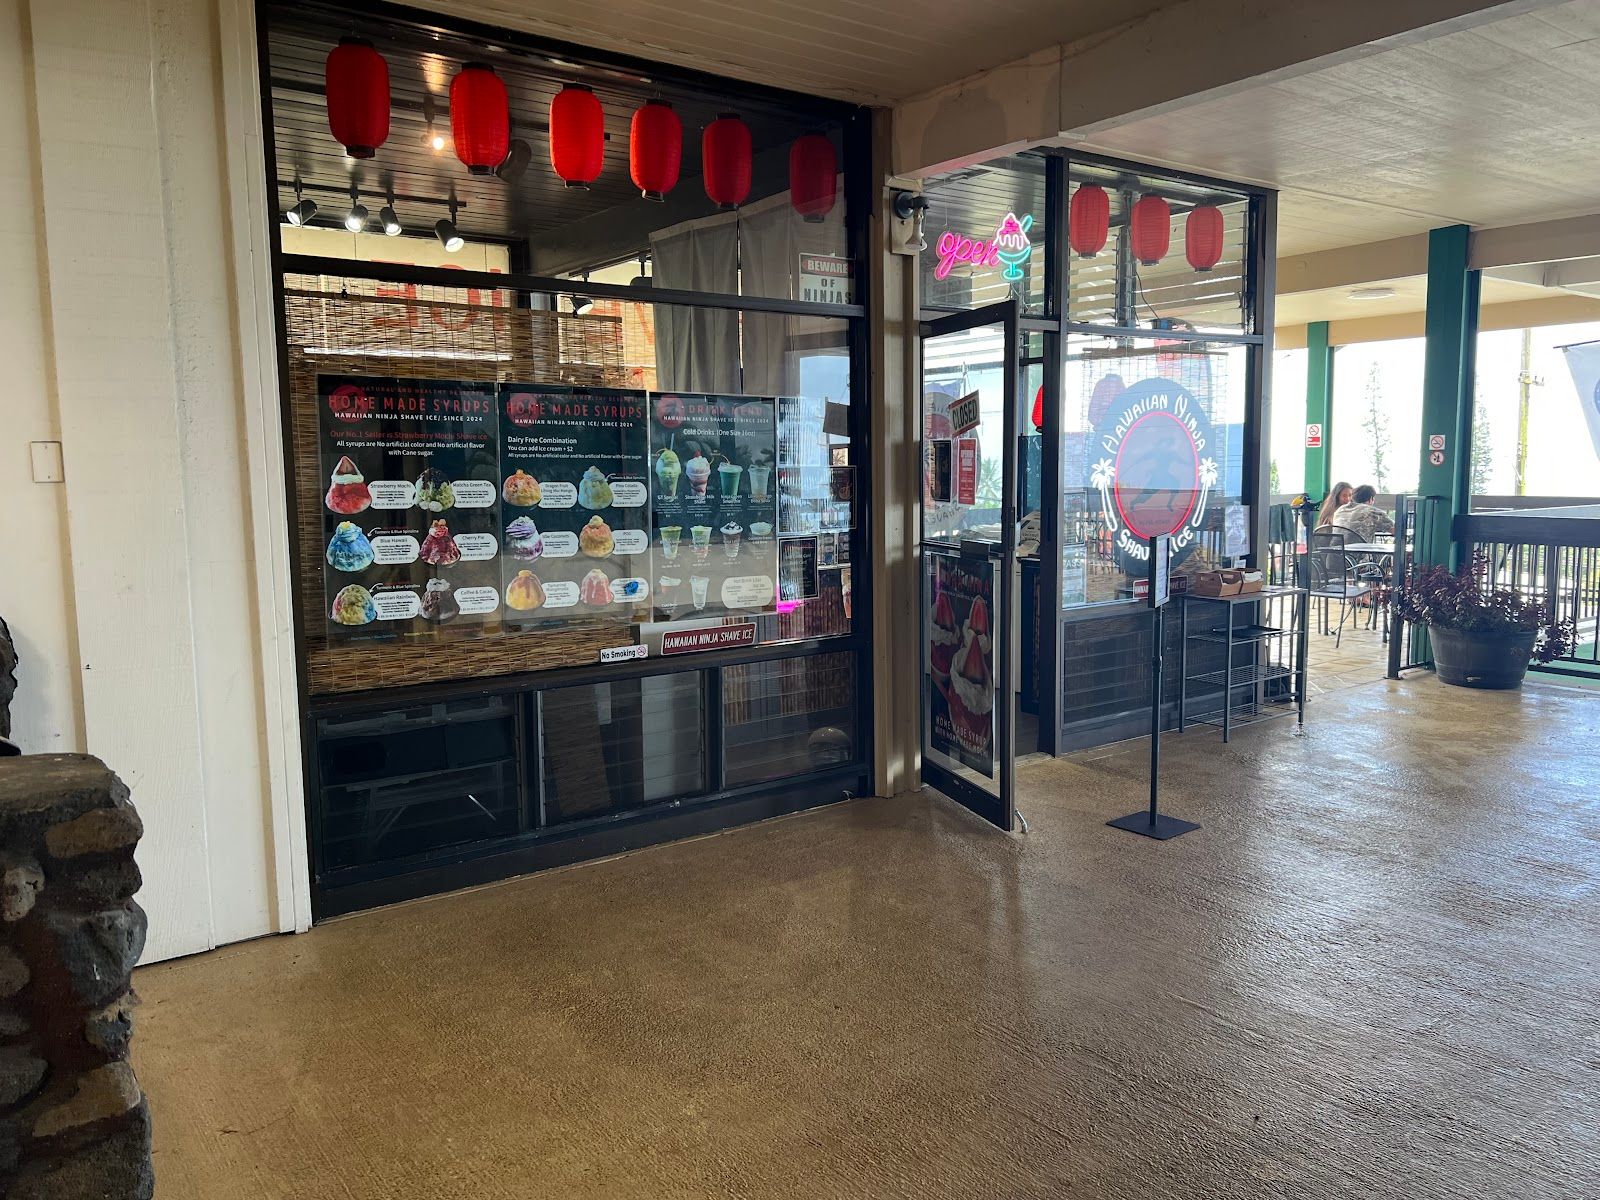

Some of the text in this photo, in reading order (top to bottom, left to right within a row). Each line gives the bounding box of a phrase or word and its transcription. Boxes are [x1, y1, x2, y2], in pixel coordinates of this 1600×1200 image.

[807, 260, 848, 273] BEWARE
[821, 278, 835, 287] OF
[804, 288, 851, 304] NINJAS
[328, 395, 489, 413] HOME MADE SYRUPS
[506, 402, 642, 419] HOME MADE SYRUPS
[952, 399, 977, 431] CLOSED
[345, 441, 365, 449] syrups
[508, 436, 524, 445] Dairy
[664, 629, 753, 649] HAWAIIAN NINJA SHAVE ICE
[601, 650, 636, 659] No Smoking
